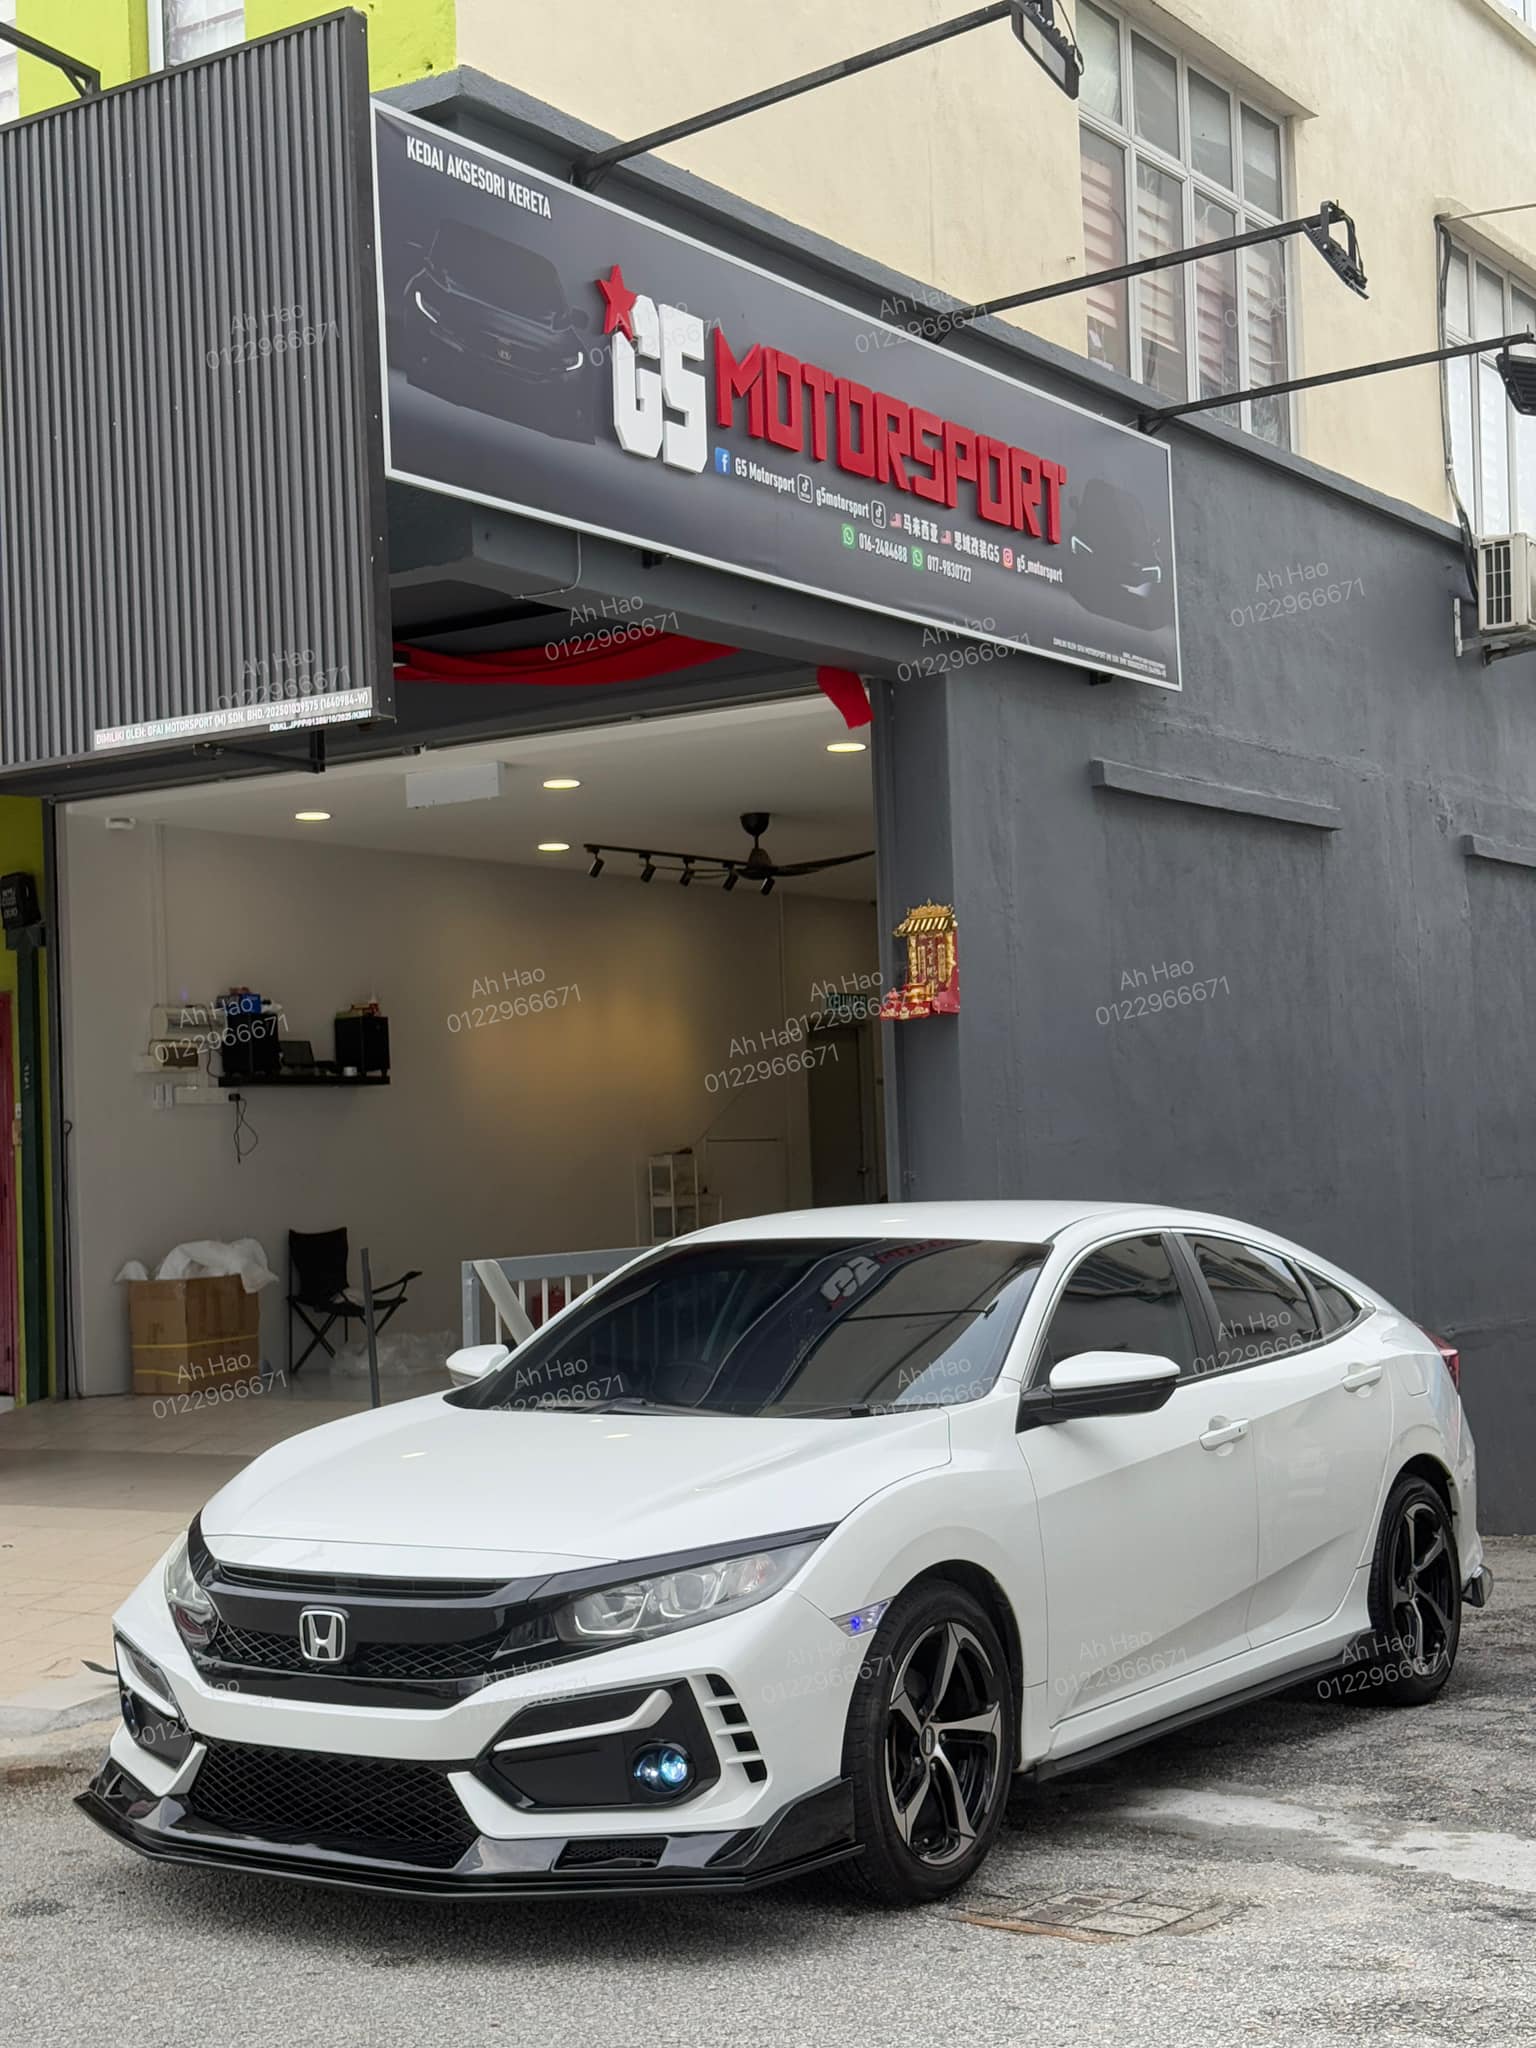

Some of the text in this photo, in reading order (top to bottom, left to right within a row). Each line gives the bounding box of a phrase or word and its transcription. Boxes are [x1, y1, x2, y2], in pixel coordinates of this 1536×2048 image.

[406, 135, 552, 219] KEDAI AKSESORI KERETA
[612, 294, 1067, 544] G5 MOTORSPORT
[735, 457, 796, 494] G5 Motorsport
[816, 486, 870, 518] g5motorsport
[903, 514, 939, 544] 马来西亚
[1016, 554, 1063, 583] g5_motorsport
[165, 718, 213, 734] MOTORSPORT
